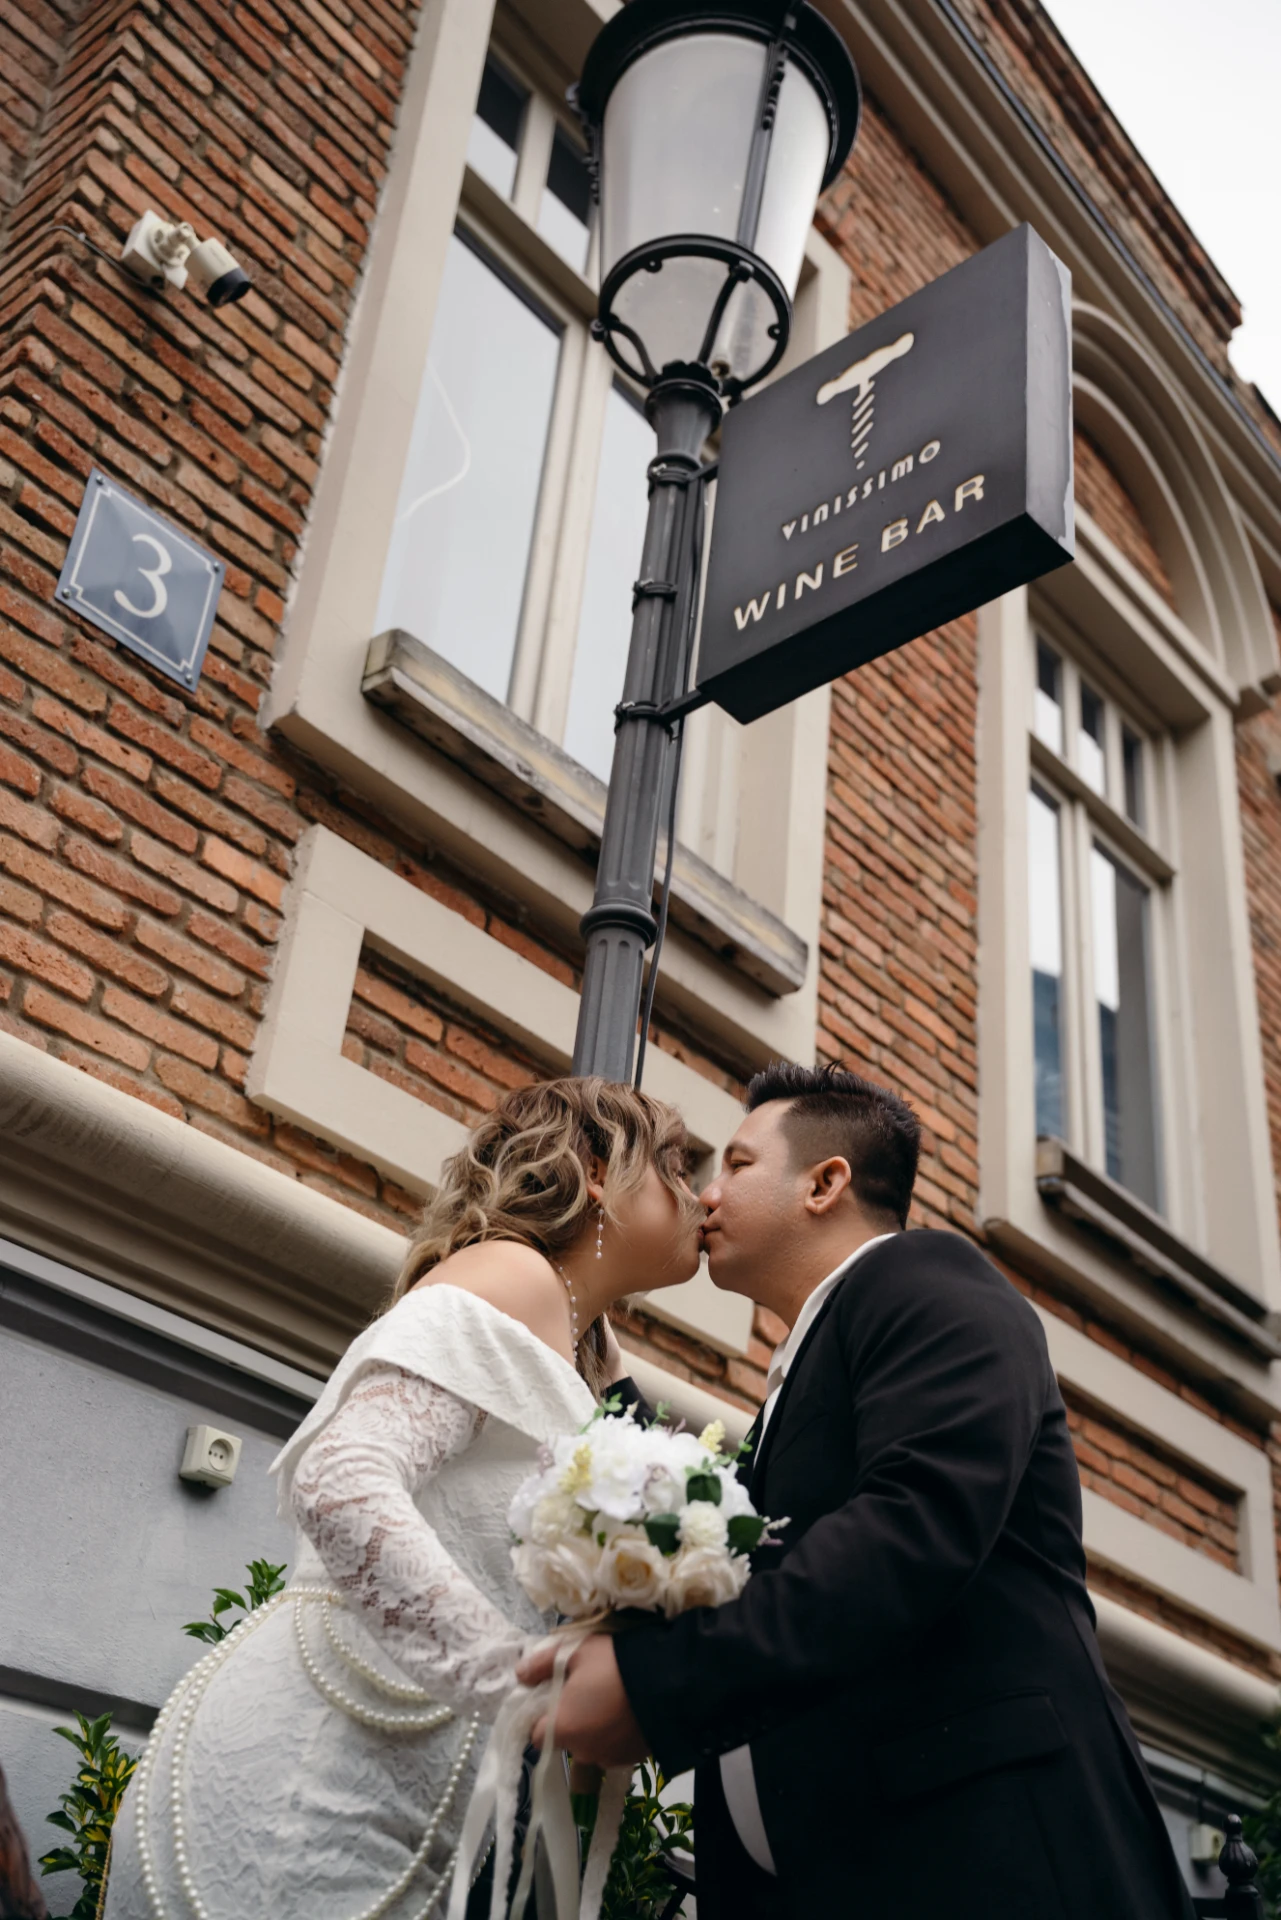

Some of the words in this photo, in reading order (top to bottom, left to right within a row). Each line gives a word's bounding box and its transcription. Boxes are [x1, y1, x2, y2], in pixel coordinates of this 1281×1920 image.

[114, 534, 172, 618] 3
[734, 543, 859, 630] WINE
[881, 474, 985, 553] BAR
